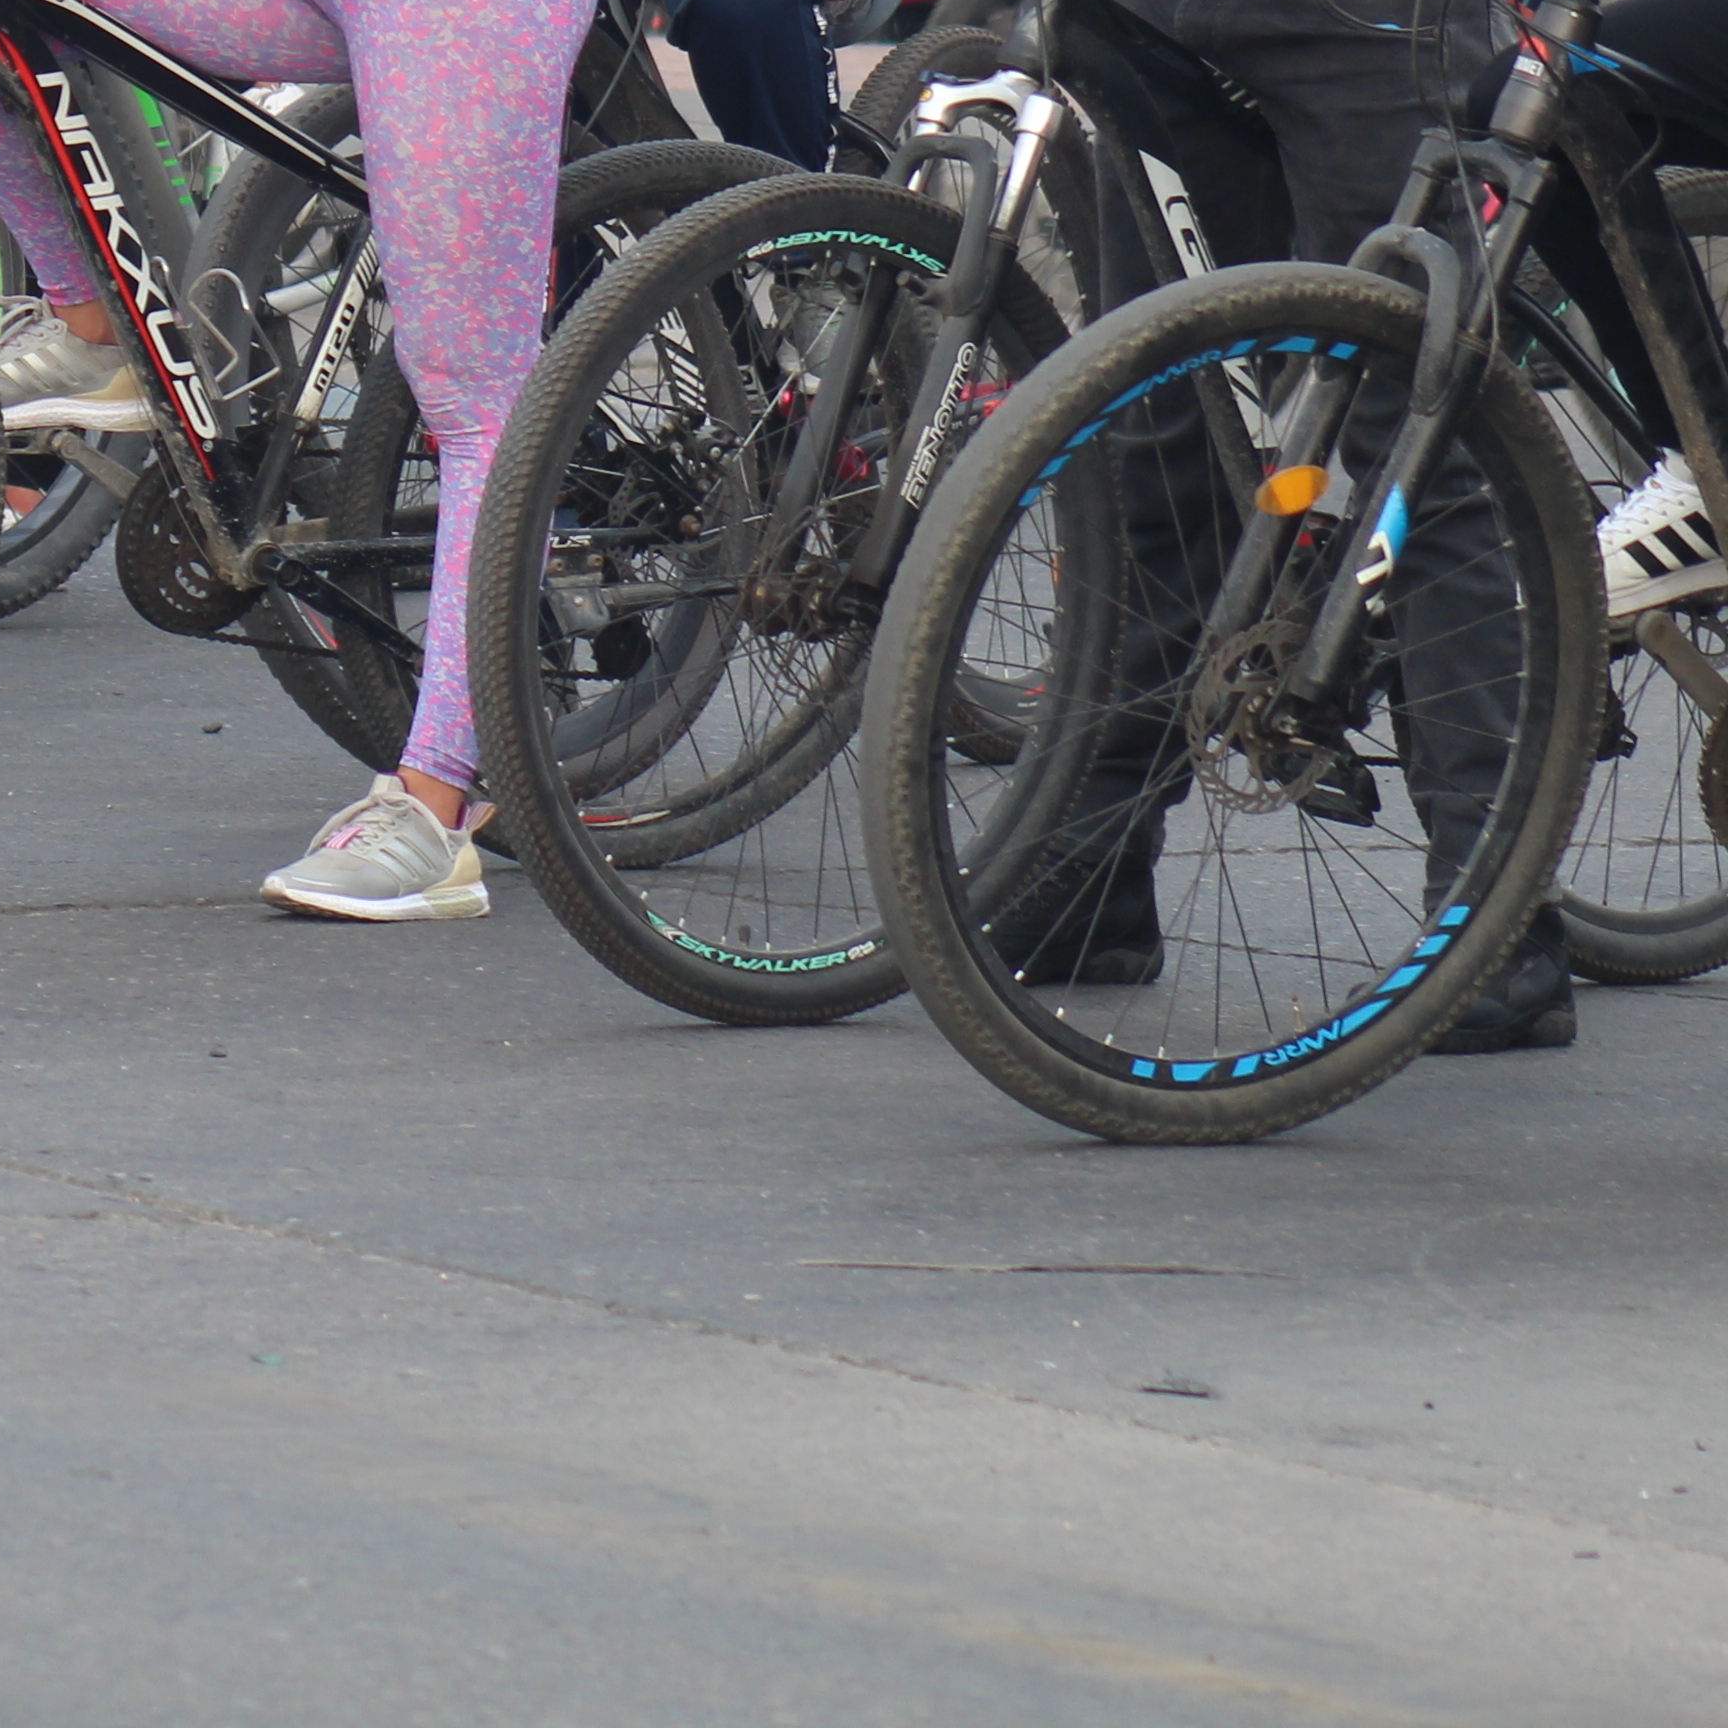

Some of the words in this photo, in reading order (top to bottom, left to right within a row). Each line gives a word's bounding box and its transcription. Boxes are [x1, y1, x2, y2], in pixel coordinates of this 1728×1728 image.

[35, 71, 217, 440] NAKXUS
[774, 230, 947, 273] SKYWALKER
[314, 302, 357, 394] MT20
[905, 341, 977, 510] BENOTTO
[674, 936, 847, 972] SKYWALKER
